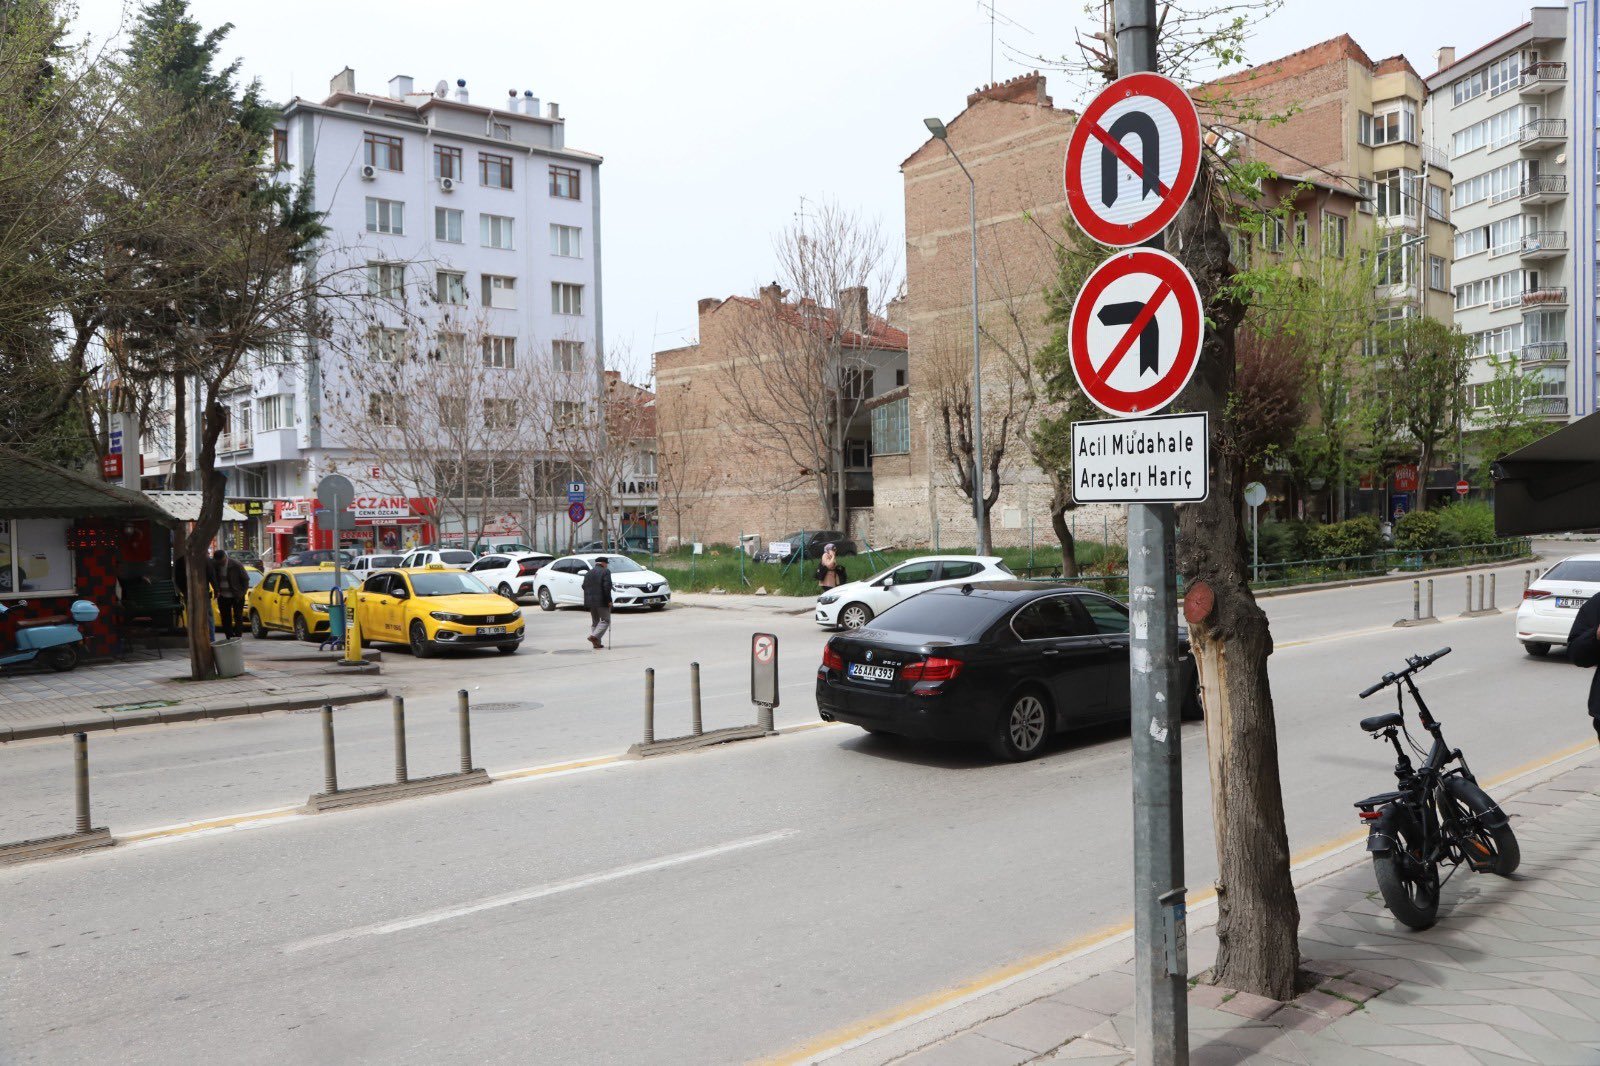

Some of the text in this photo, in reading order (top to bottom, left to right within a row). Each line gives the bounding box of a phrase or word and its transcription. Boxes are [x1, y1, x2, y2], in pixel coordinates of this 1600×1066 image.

[1079, 431, 1193, 457] Acil Müdahale
[372, 467, 380, 479] E
[1080, 465, 1192, 490] Araçları Hariç
[349, 496, 408, 509] ECZANE
[340, 531, 374, 539] ECZANE
[1560, 598, 1569, 606] 26
[854, 664, 863, 674] 26
[863, 666, 878, 677] AAK
[878, 668, 893, 679] 393
